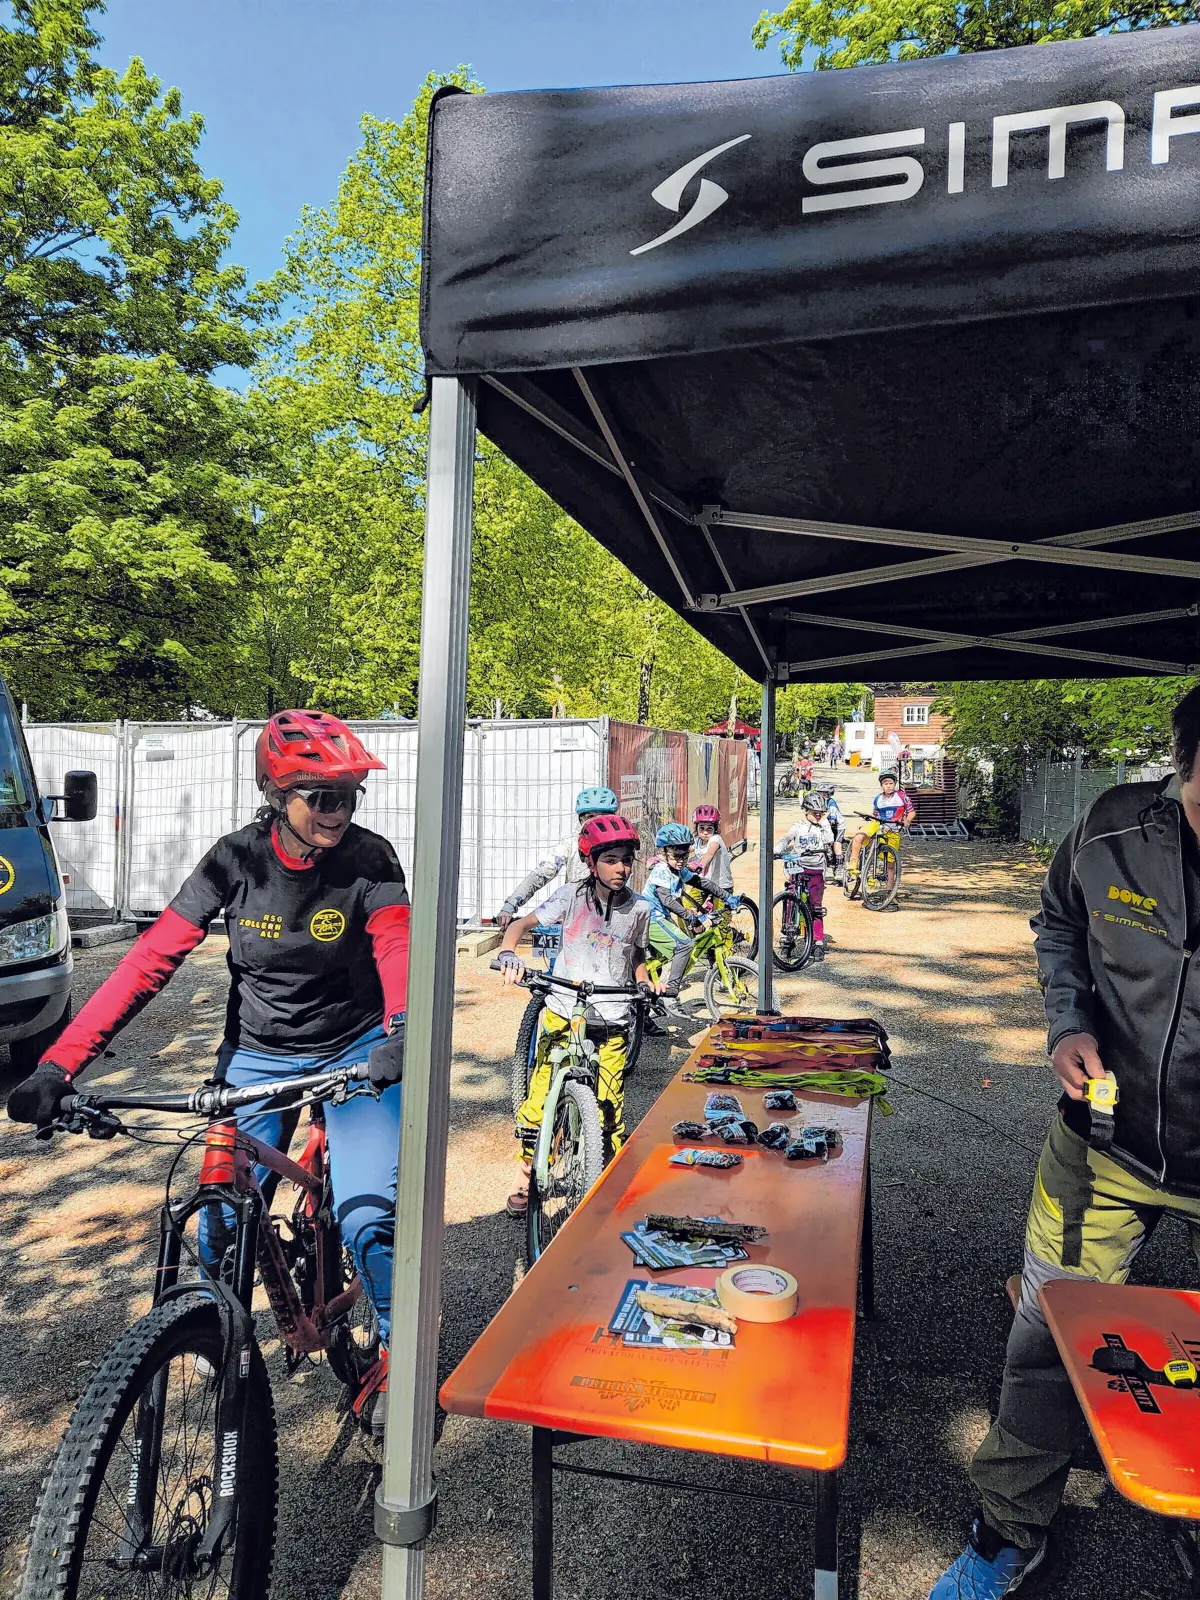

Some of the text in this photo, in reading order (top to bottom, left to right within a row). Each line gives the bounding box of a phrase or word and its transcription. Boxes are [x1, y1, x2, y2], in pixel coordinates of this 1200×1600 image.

[239, 918, 282, 930] ZOLLERN
[262, 914, 283, 923] RSG
[1103, 913, 1168, 937] SIMPLON
[260, 930, 280, 939] ALB
[580, 1377, 706, 1401] FEIERN SIE MIT
[219, 1431, 238, 1497] ROCKSHOX
